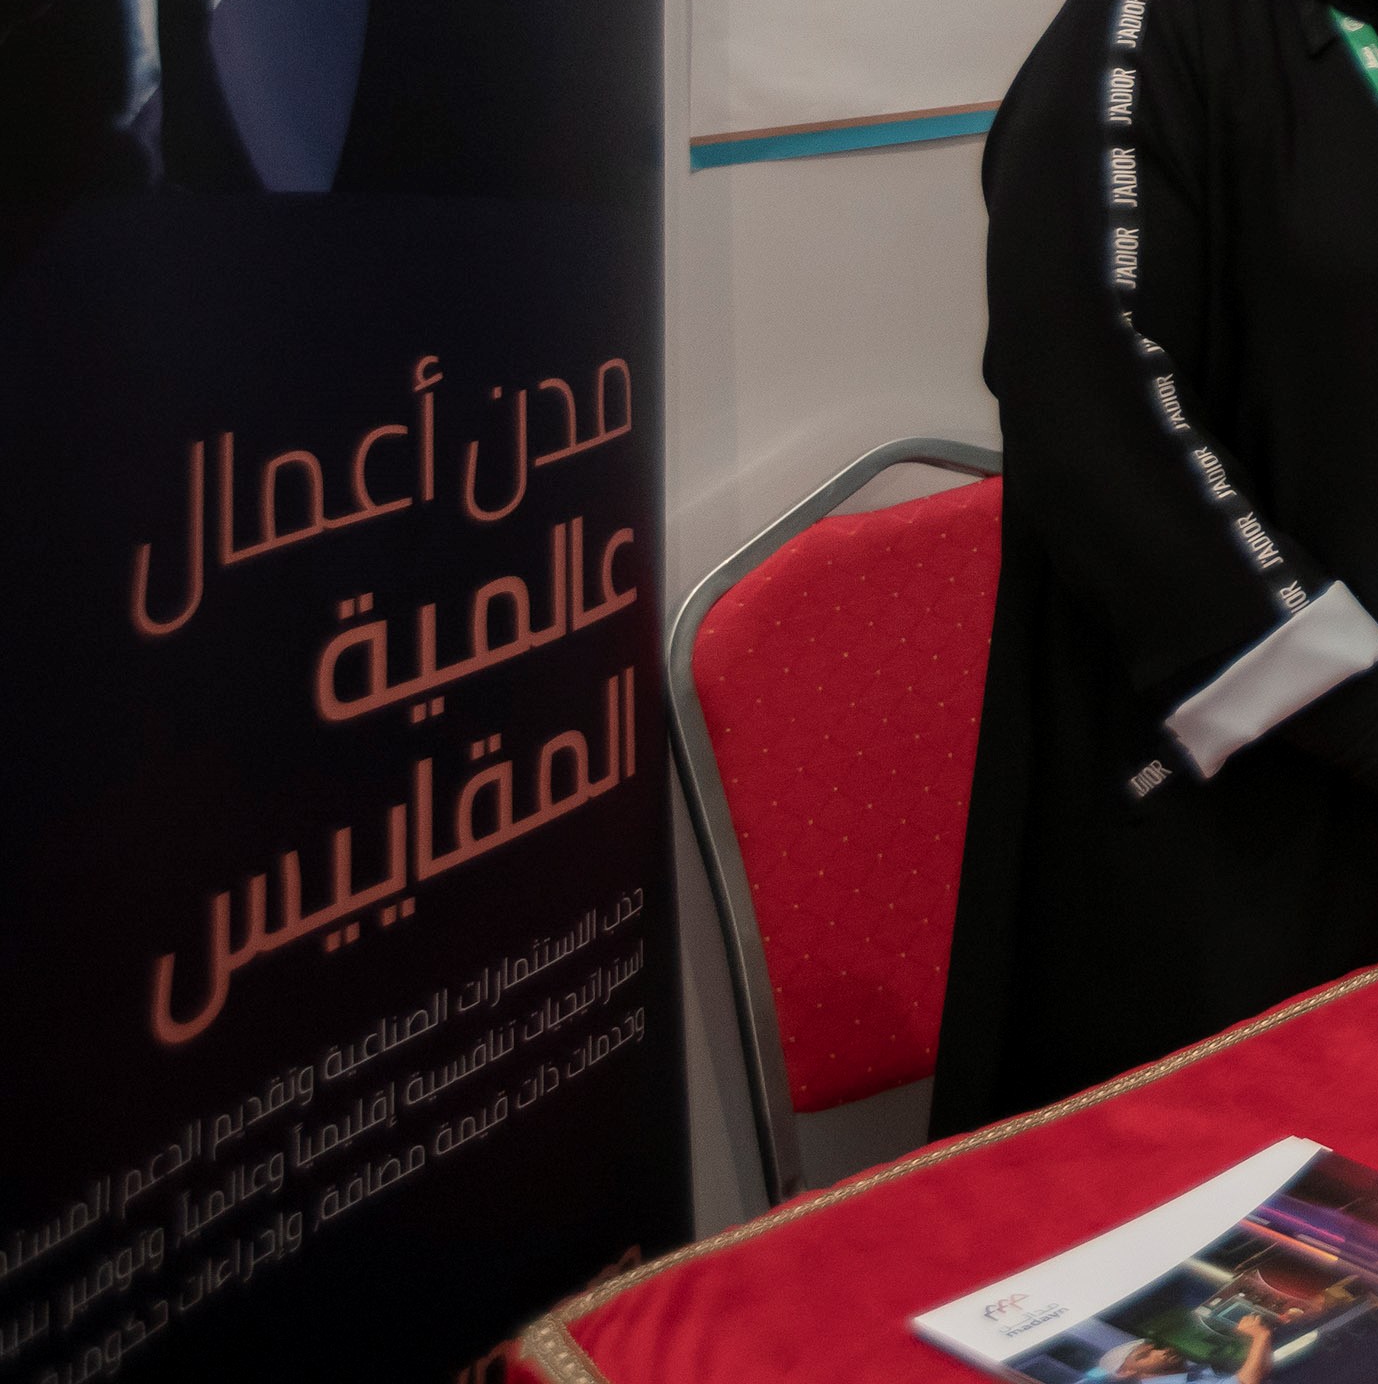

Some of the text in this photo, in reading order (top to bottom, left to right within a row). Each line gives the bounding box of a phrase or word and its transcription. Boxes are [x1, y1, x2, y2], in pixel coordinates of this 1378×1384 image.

[1109, 67, 1137, 126] J'ADIOR
[1112, 146, 1139, 209] J'ADIOR
[1115, 225, 1140, 290] J'ADIOR
[129, 353, 634, 638] مدن أعمال
[312, 514, 640, 726] عالمية
[148, 665, 638, 1049] المقاييس
[602, 887, 645, 935] جذب
[458, 907, 598, 1012] الاستثمارات
[323, 988, 448, 1080] الصناعية
[404, 1019, 516, 1106] تنافسية
[433, 1005, 645, 1157] وخدمات ذات قيمة
[1006, 1306, 1071, 1338] madayn
